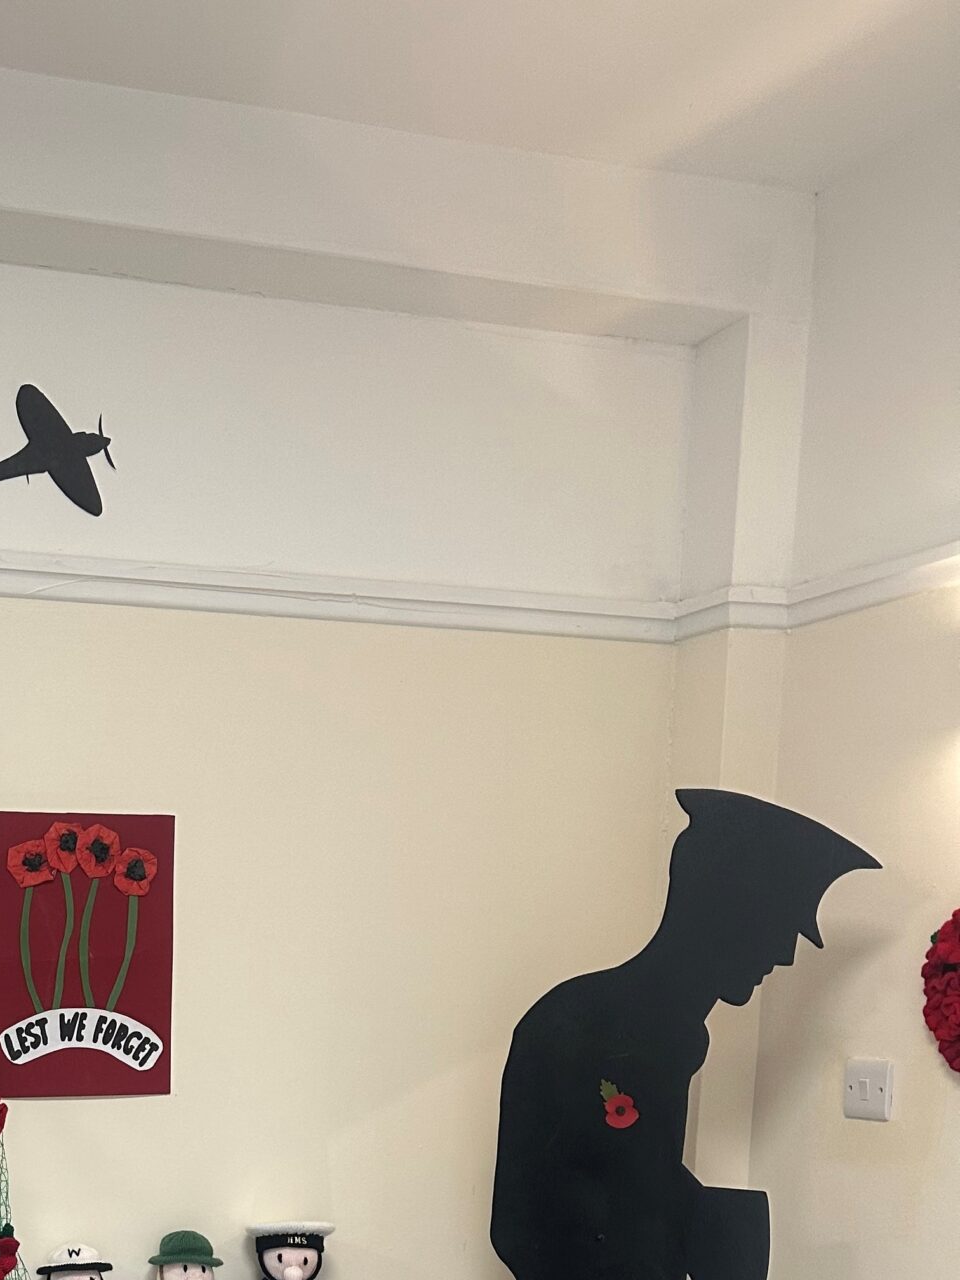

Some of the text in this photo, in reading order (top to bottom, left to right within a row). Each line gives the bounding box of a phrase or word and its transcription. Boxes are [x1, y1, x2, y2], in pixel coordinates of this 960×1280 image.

[4, 1012, 159, 1067] LEST WE FORGET
[68, 1248, 81, 1258] W
